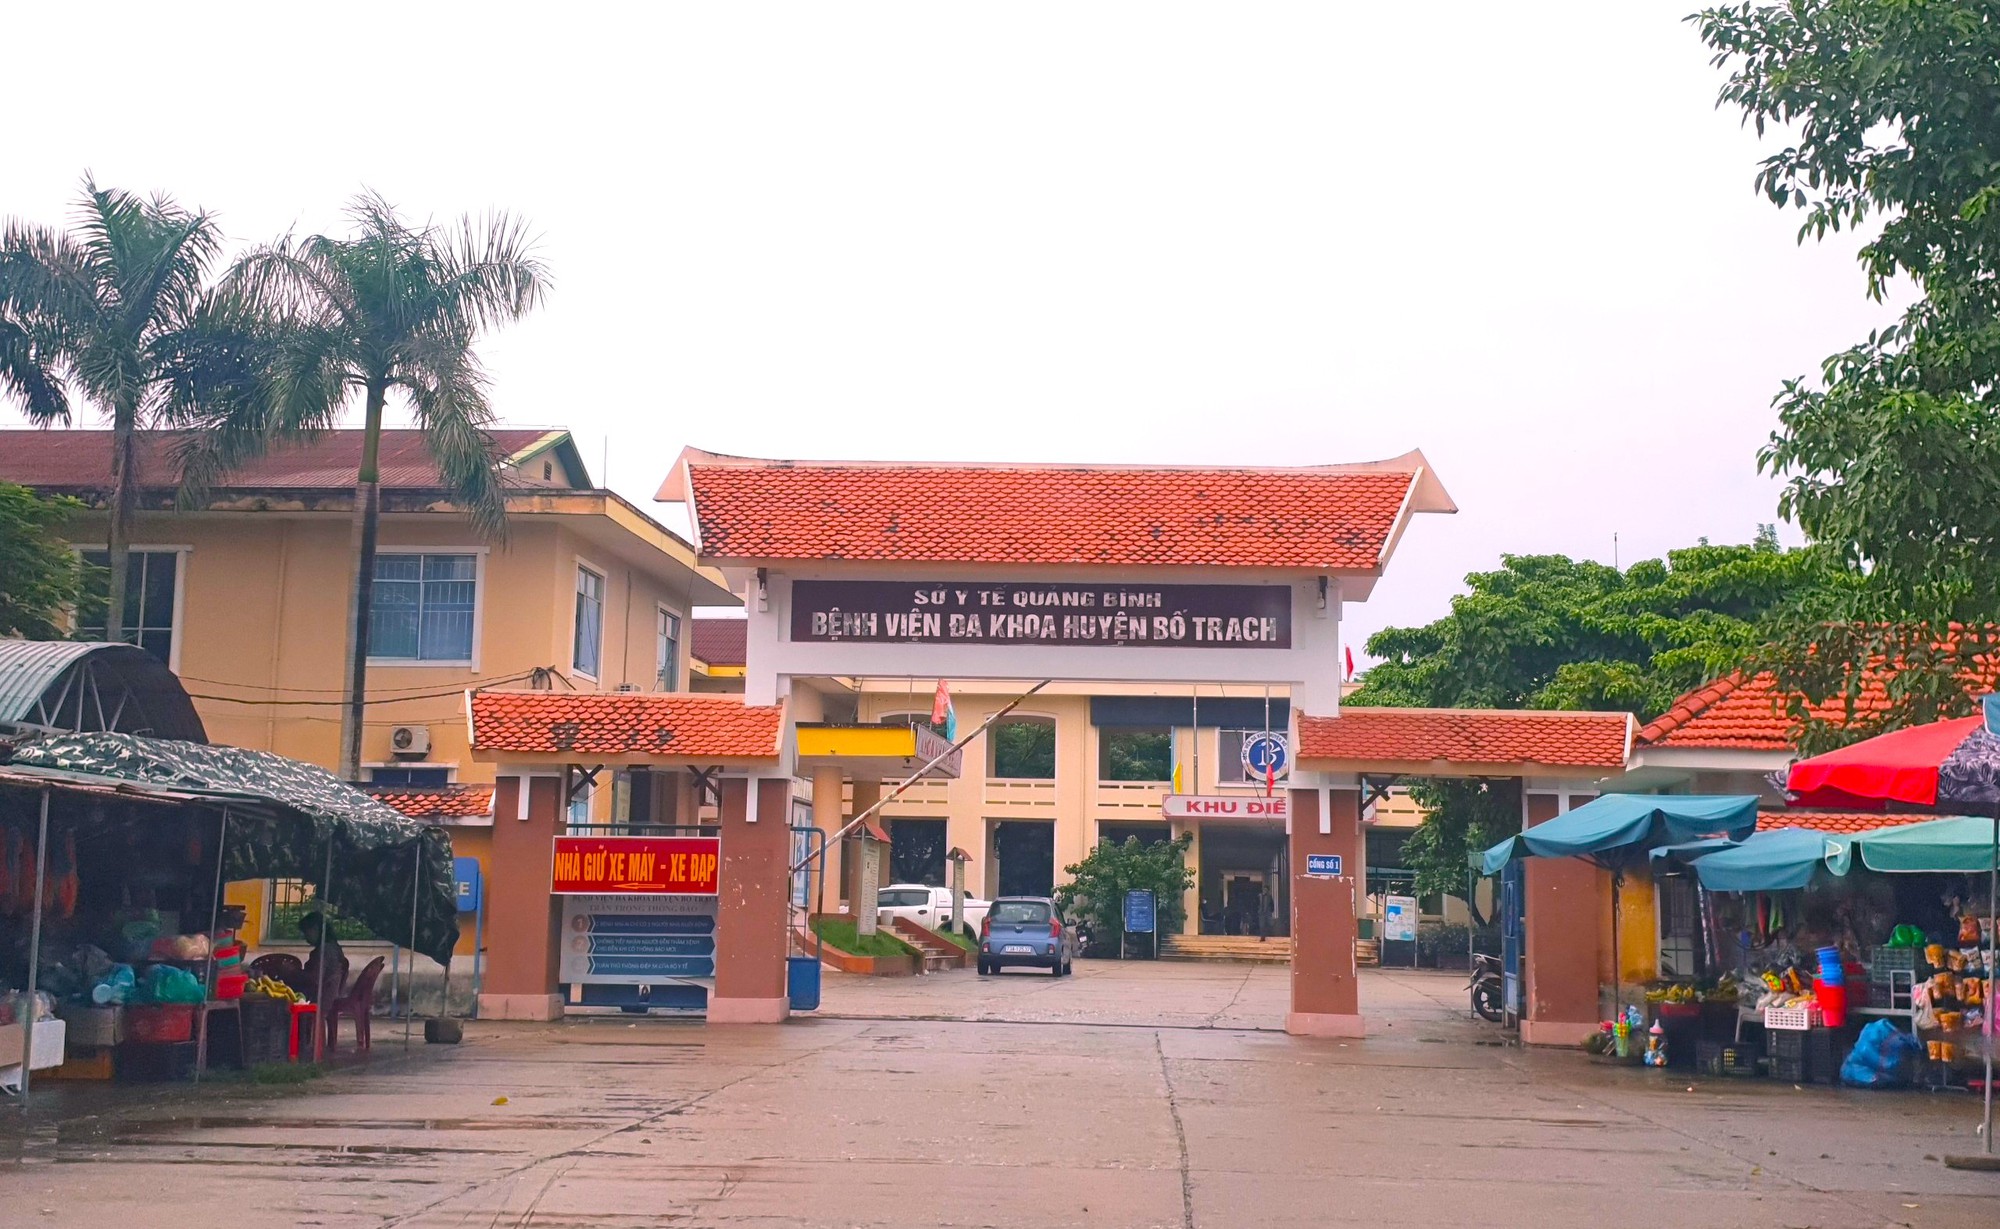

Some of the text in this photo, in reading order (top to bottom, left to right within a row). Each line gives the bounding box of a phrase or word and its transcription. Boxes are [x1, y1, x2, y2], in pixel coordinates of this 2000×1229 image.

[955, 590, 969, 605] Y
[978, 584, 1006, 606] TẾ
[1103, 588, 1161, 607] BÌNH
[811, 607, 878, 641] BỆNH
[885, 607, 941, 641] VIỆN
[949, 613, 983, 638] ĐA
[990, 614, 1057, 639] KHOA
[1063, 611, 1147, 645] HUYỆN
[1153, 609, 1188, 641] BỐ
[1186, 798, 1286, 814] KHU ĐIỀ
[555, 845, 580, 881] NHÀ
[583, 845, 607, 881] GIỮ
[609, 853, 624, 881] XE
[628, 846, 655, 881] MÁY
[669, 853, 686, 882] XE
[690, 853, 716, 887] ĐẠP
[1335, 860, 1339, 870] 1
[454, 881, 470, 896] E
